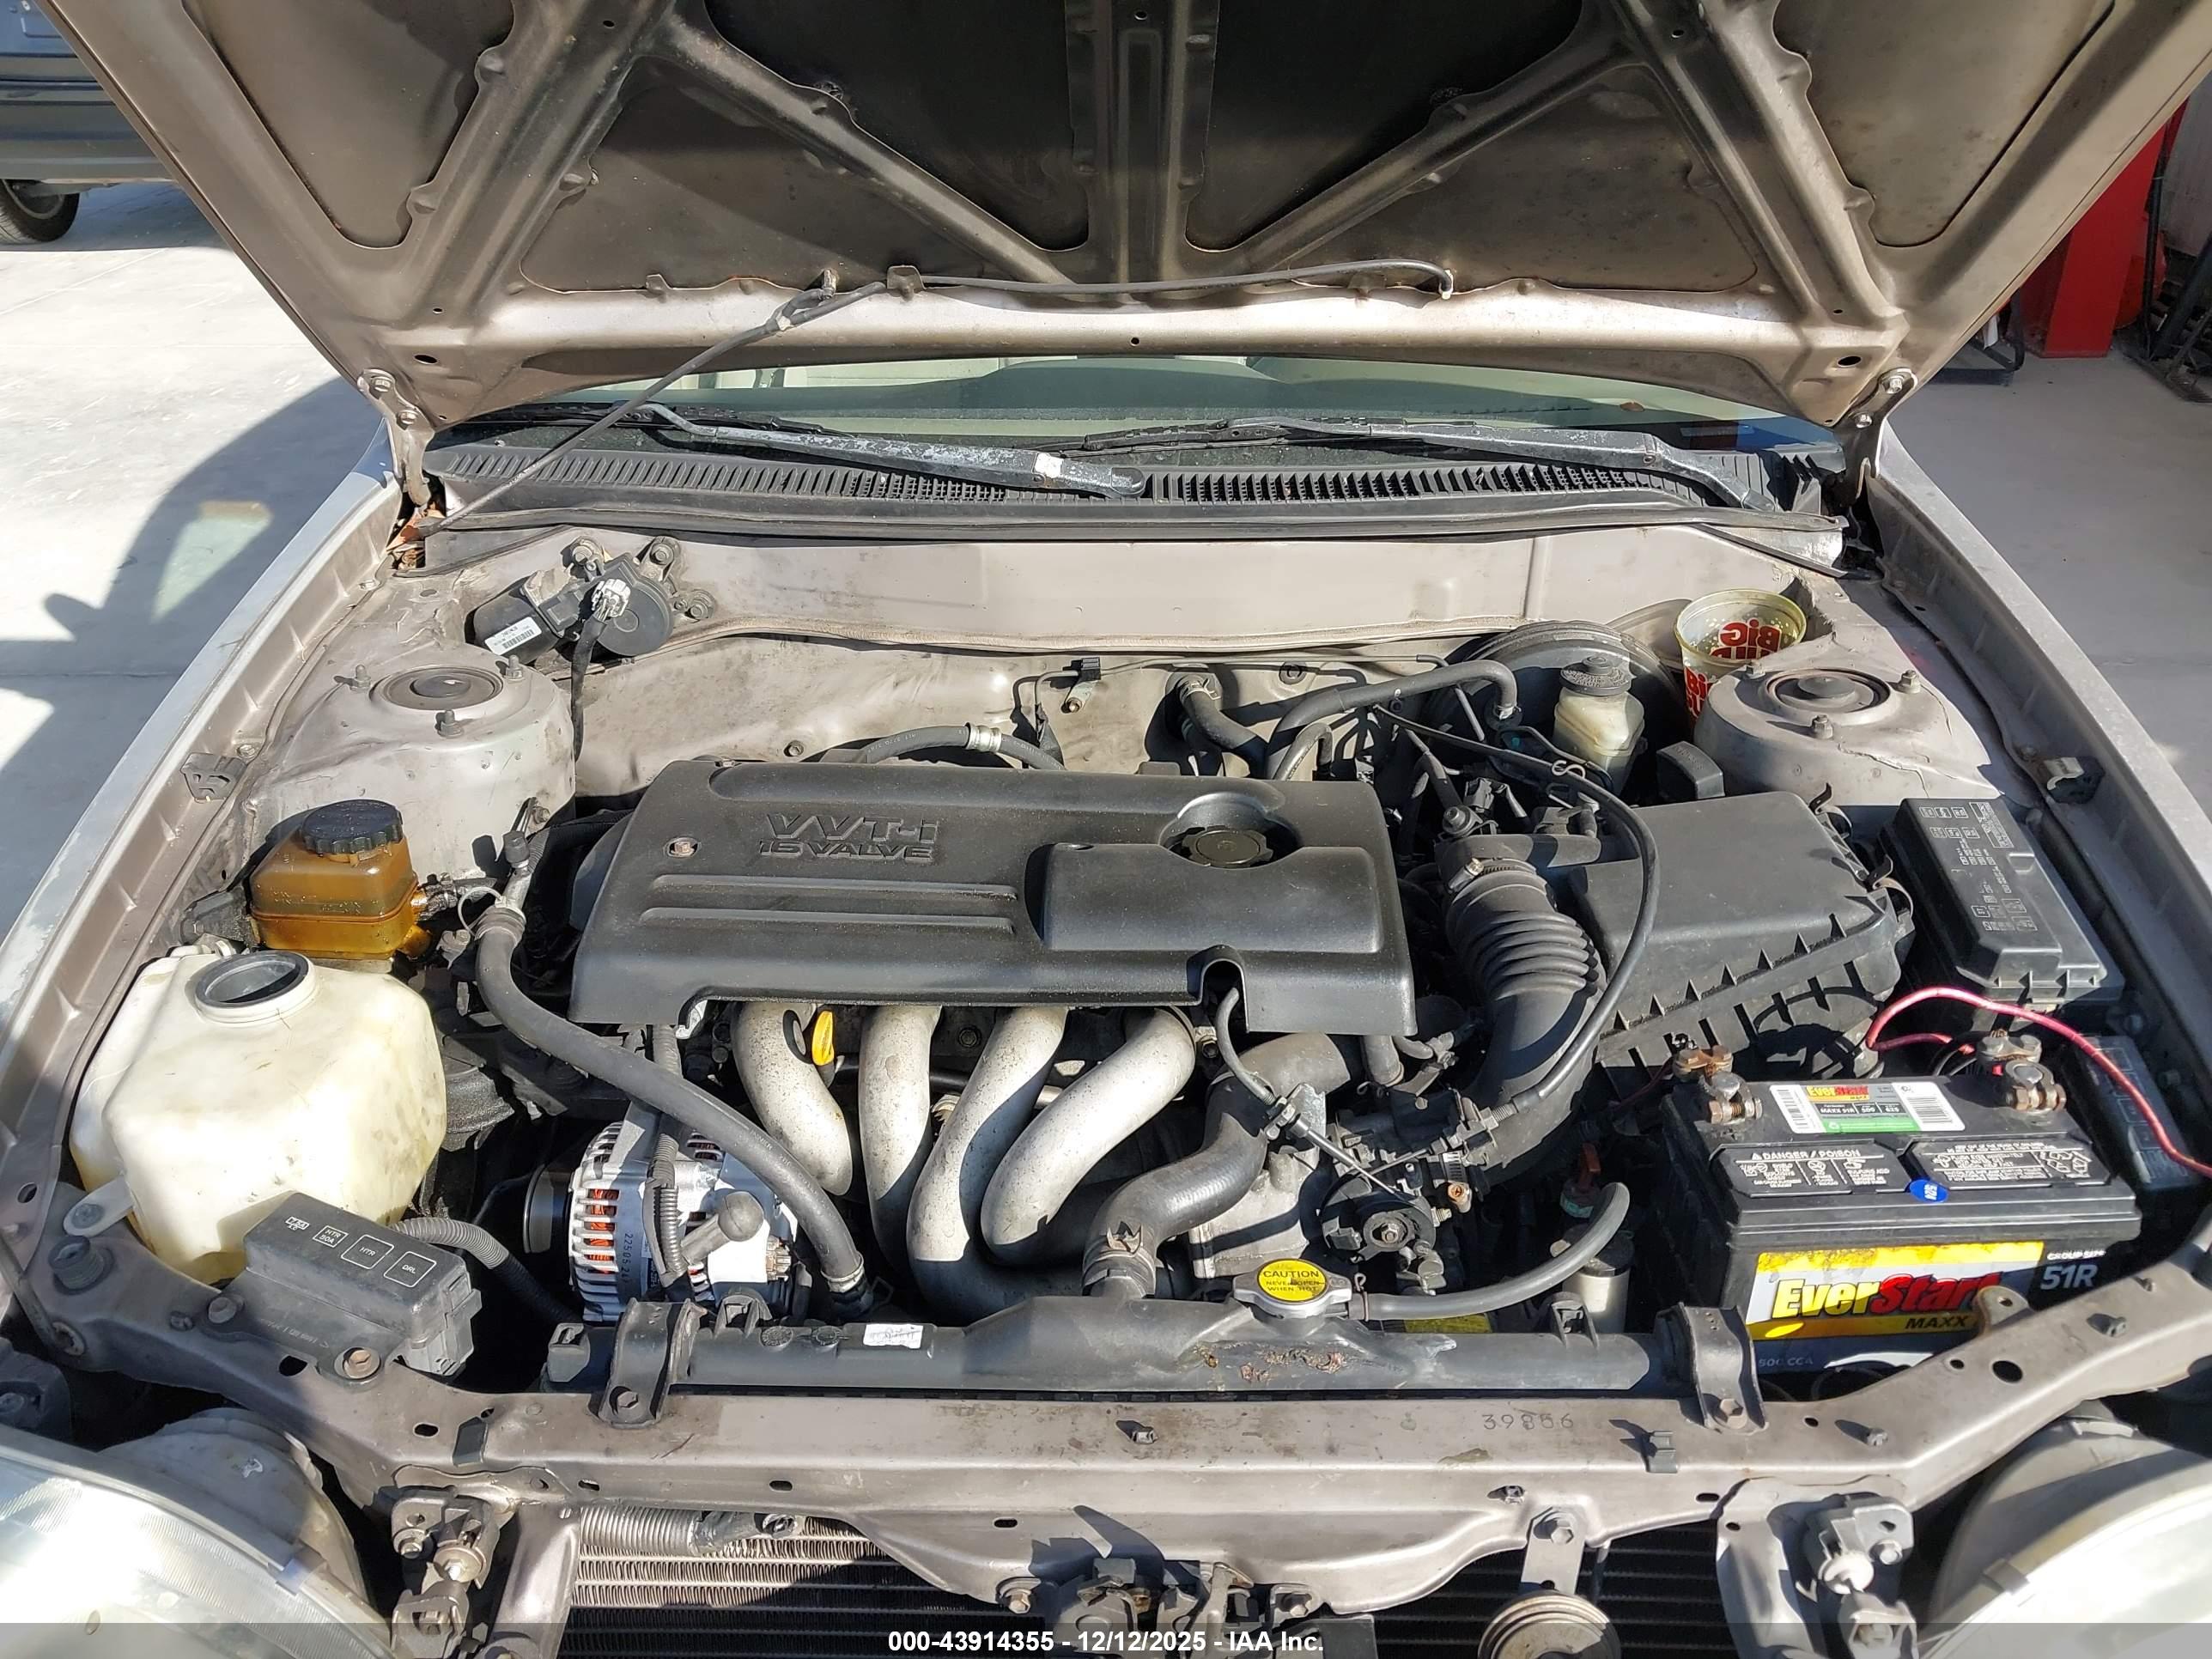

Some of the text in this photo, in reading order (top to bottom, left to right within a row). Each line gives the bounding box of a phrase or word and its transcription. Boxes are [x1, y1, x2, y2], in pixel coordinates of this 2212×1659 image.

[1685, 667, 1711, 701] Bi
[806, 842, 935, 863] VALVE
[1819, 1149, 1862, 1158] POISON
[325, 1229, 342, 1238] HTR
[319, 1235, 335, 1244] 50A
[359, 1246, 376, 1256] HTR
[401, 1264, 416, 1274] DRL
[2039, 1264, 2099, 1291] 51R
[1905, 1316, 1970, 1330] MAXX
